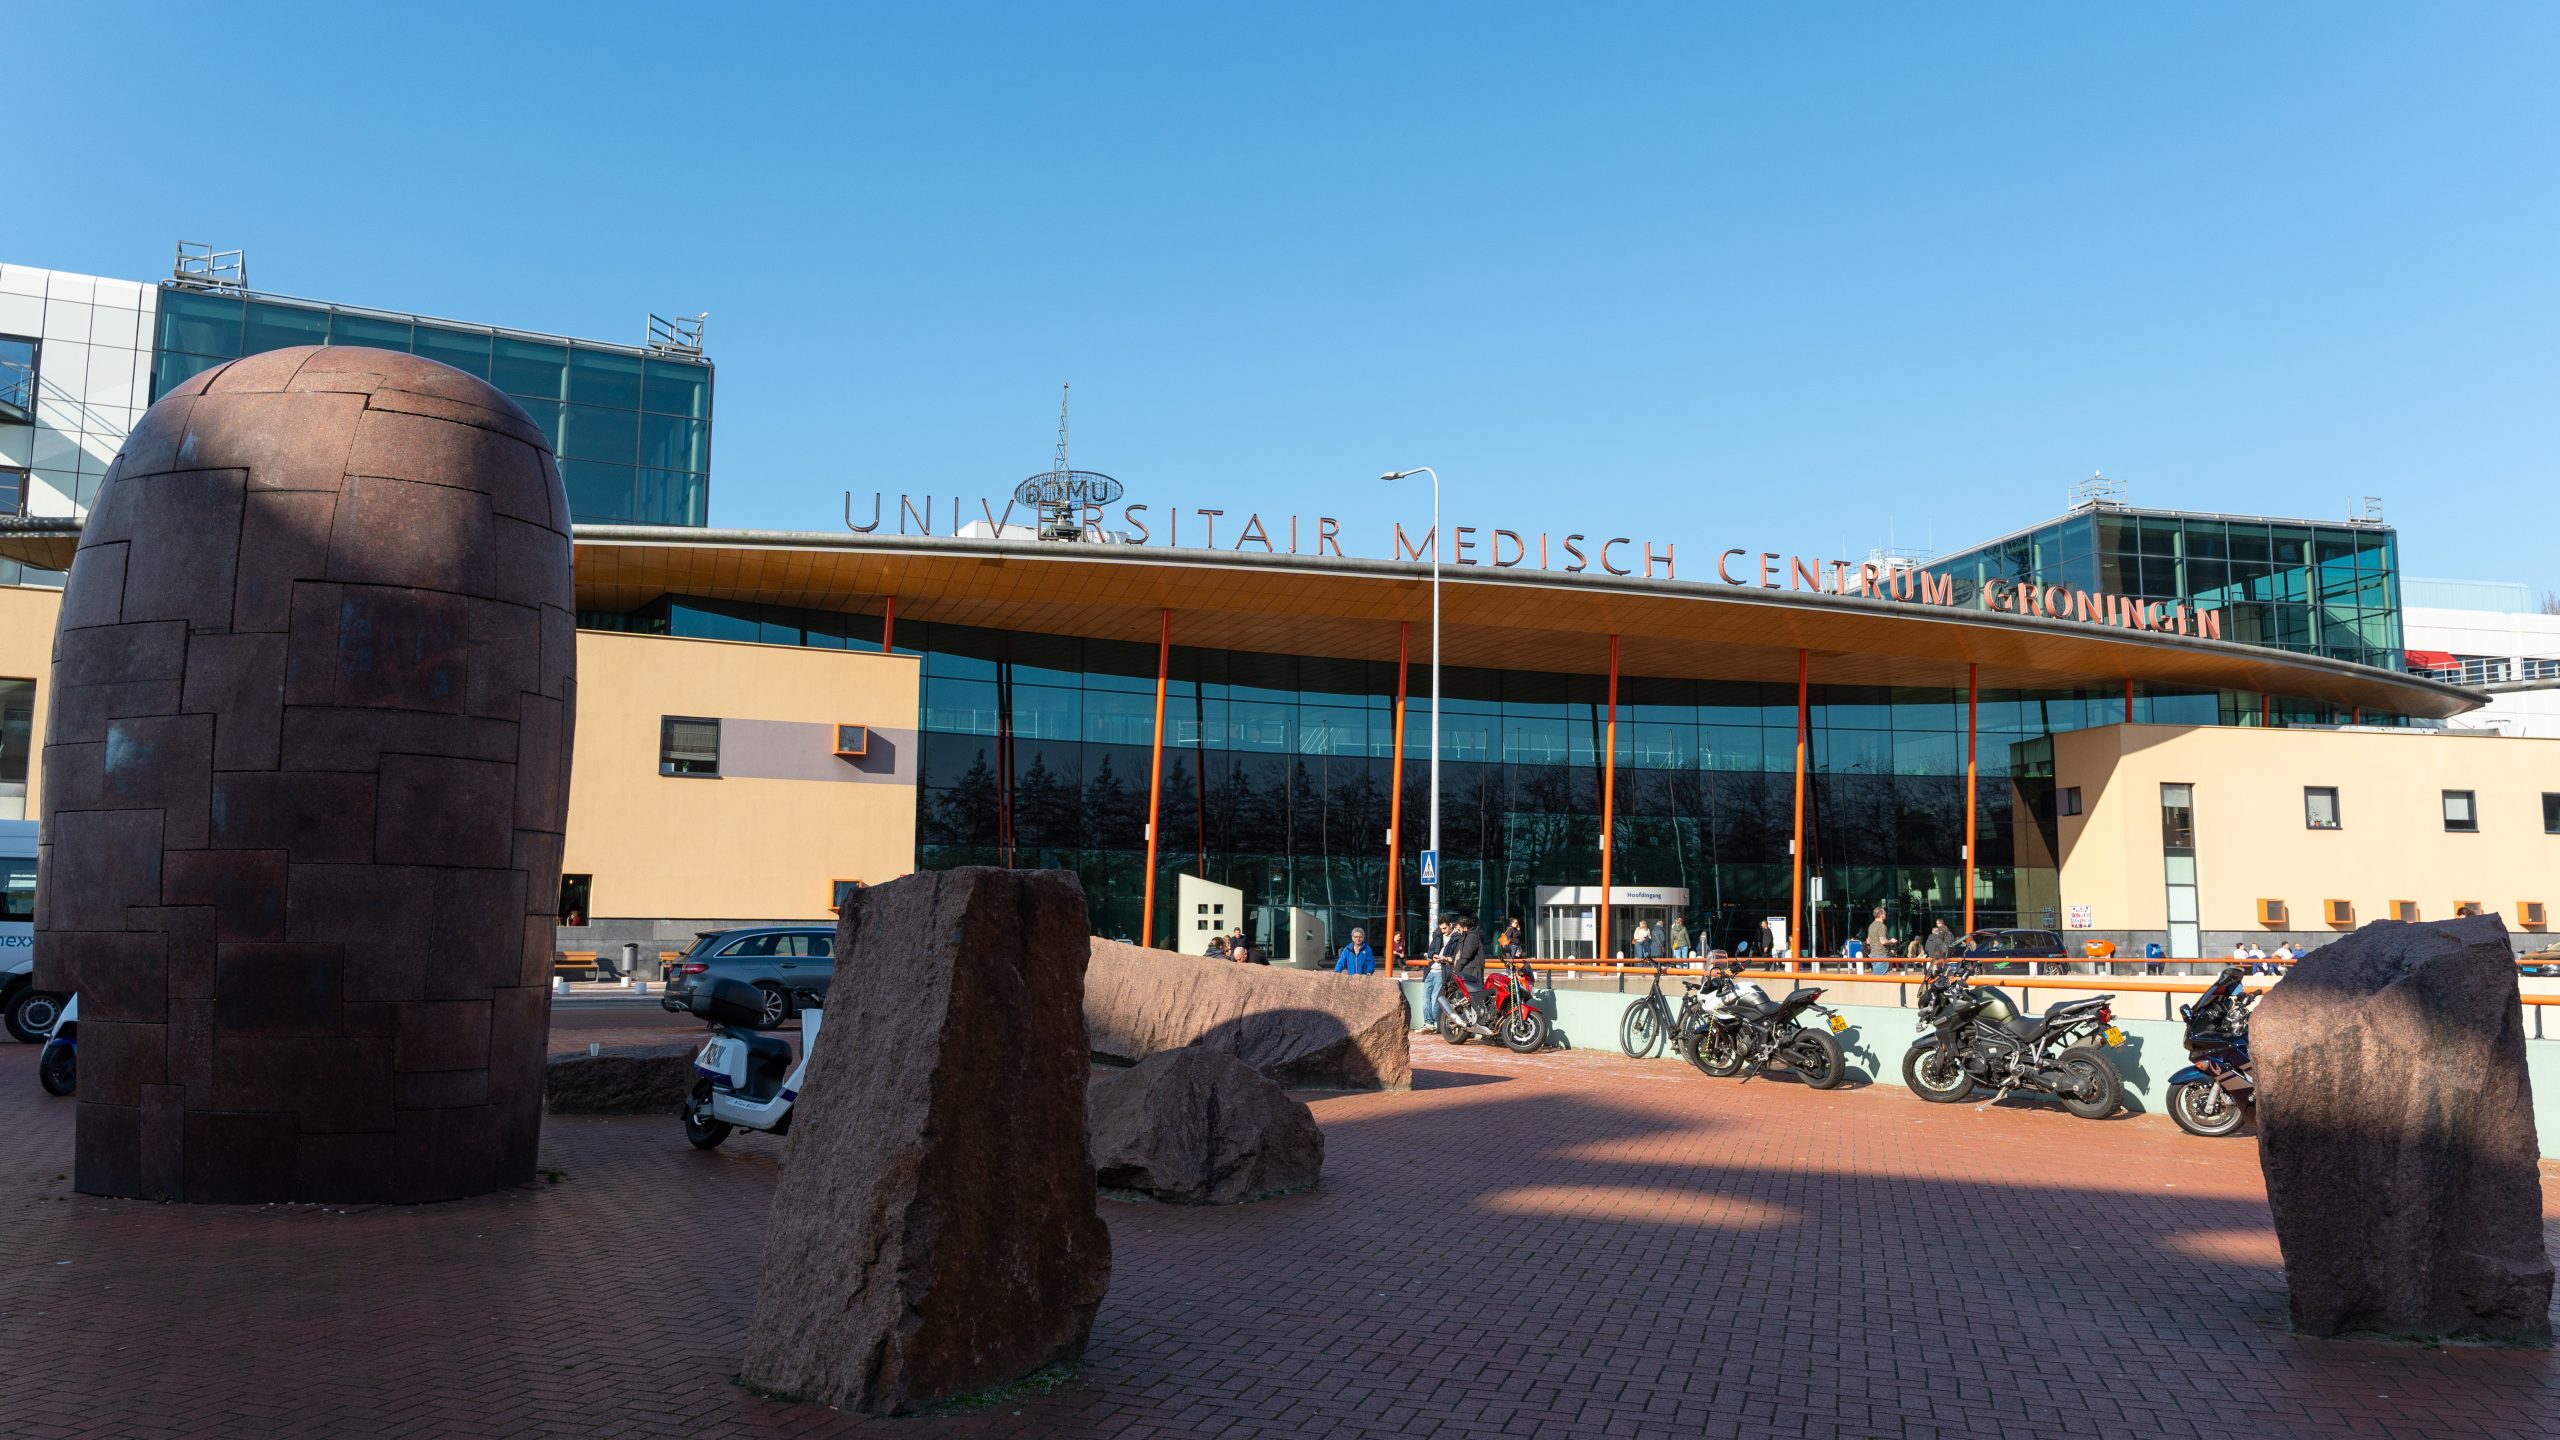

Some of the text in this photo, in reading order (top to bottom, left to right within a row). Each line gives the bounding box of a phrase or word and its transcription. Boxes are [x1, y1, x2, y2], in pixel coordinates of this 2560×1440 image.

[844, 490, 2222, 641] UNIVERSITAIR MEDISCH CENTRUM GRONINGEN
[1627, 891, 1662, 901] Hoofdingang
